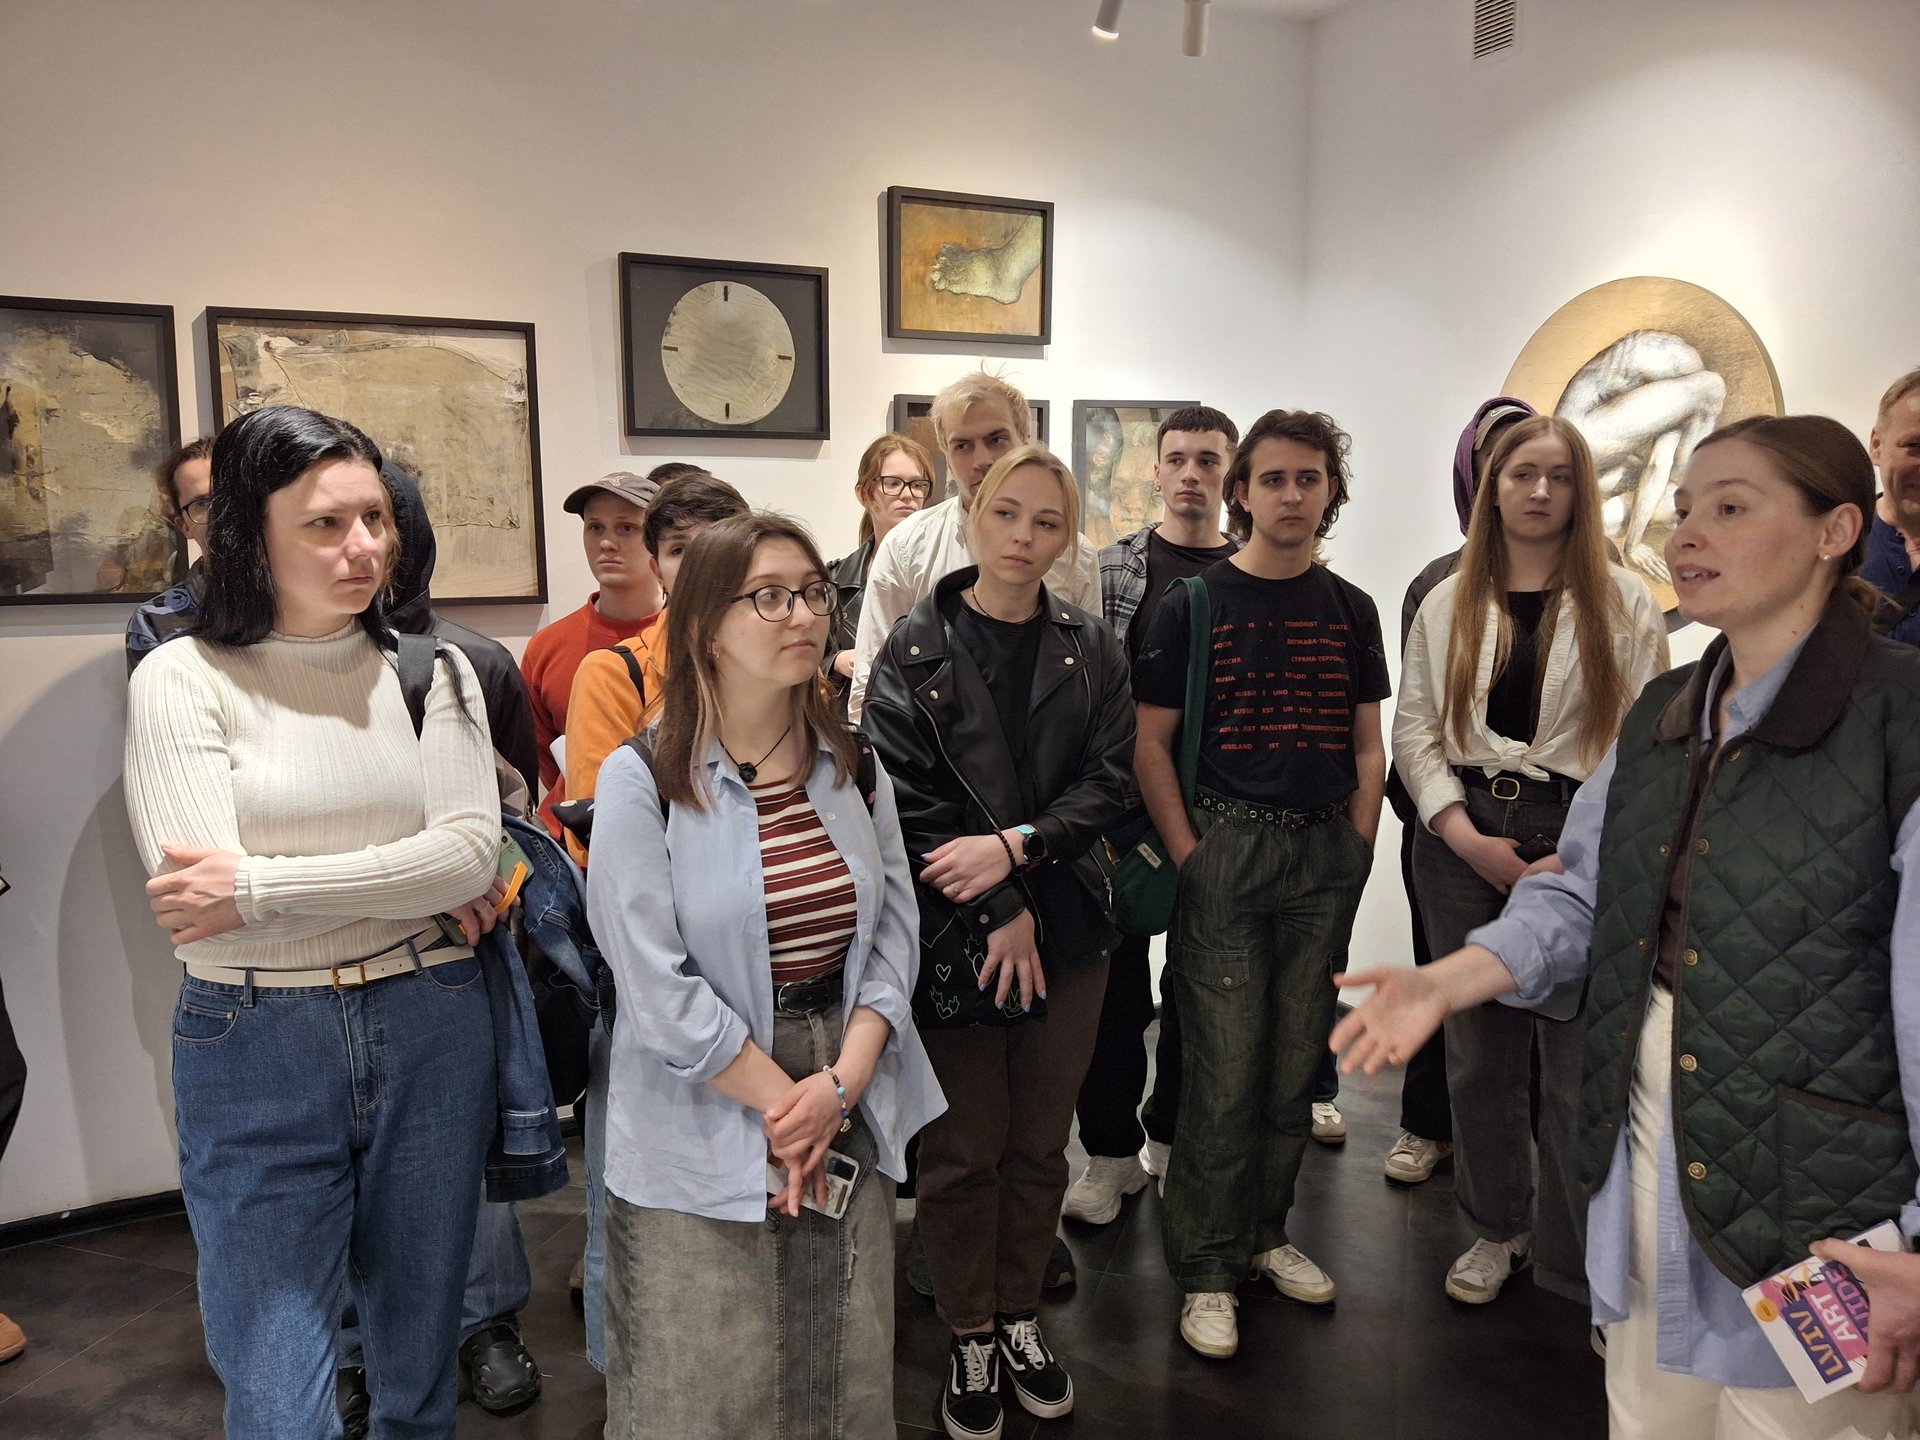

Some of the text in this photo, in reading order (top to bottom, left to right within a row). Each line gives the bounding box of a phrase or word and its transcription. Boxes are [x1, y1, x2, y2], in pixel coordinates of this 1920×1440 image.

[1810, 1294, 1857, 1341] ART
[1825, 1263, 1869, 1332] UIDE
[1790, 1309, 1843, 1376] LVIV
